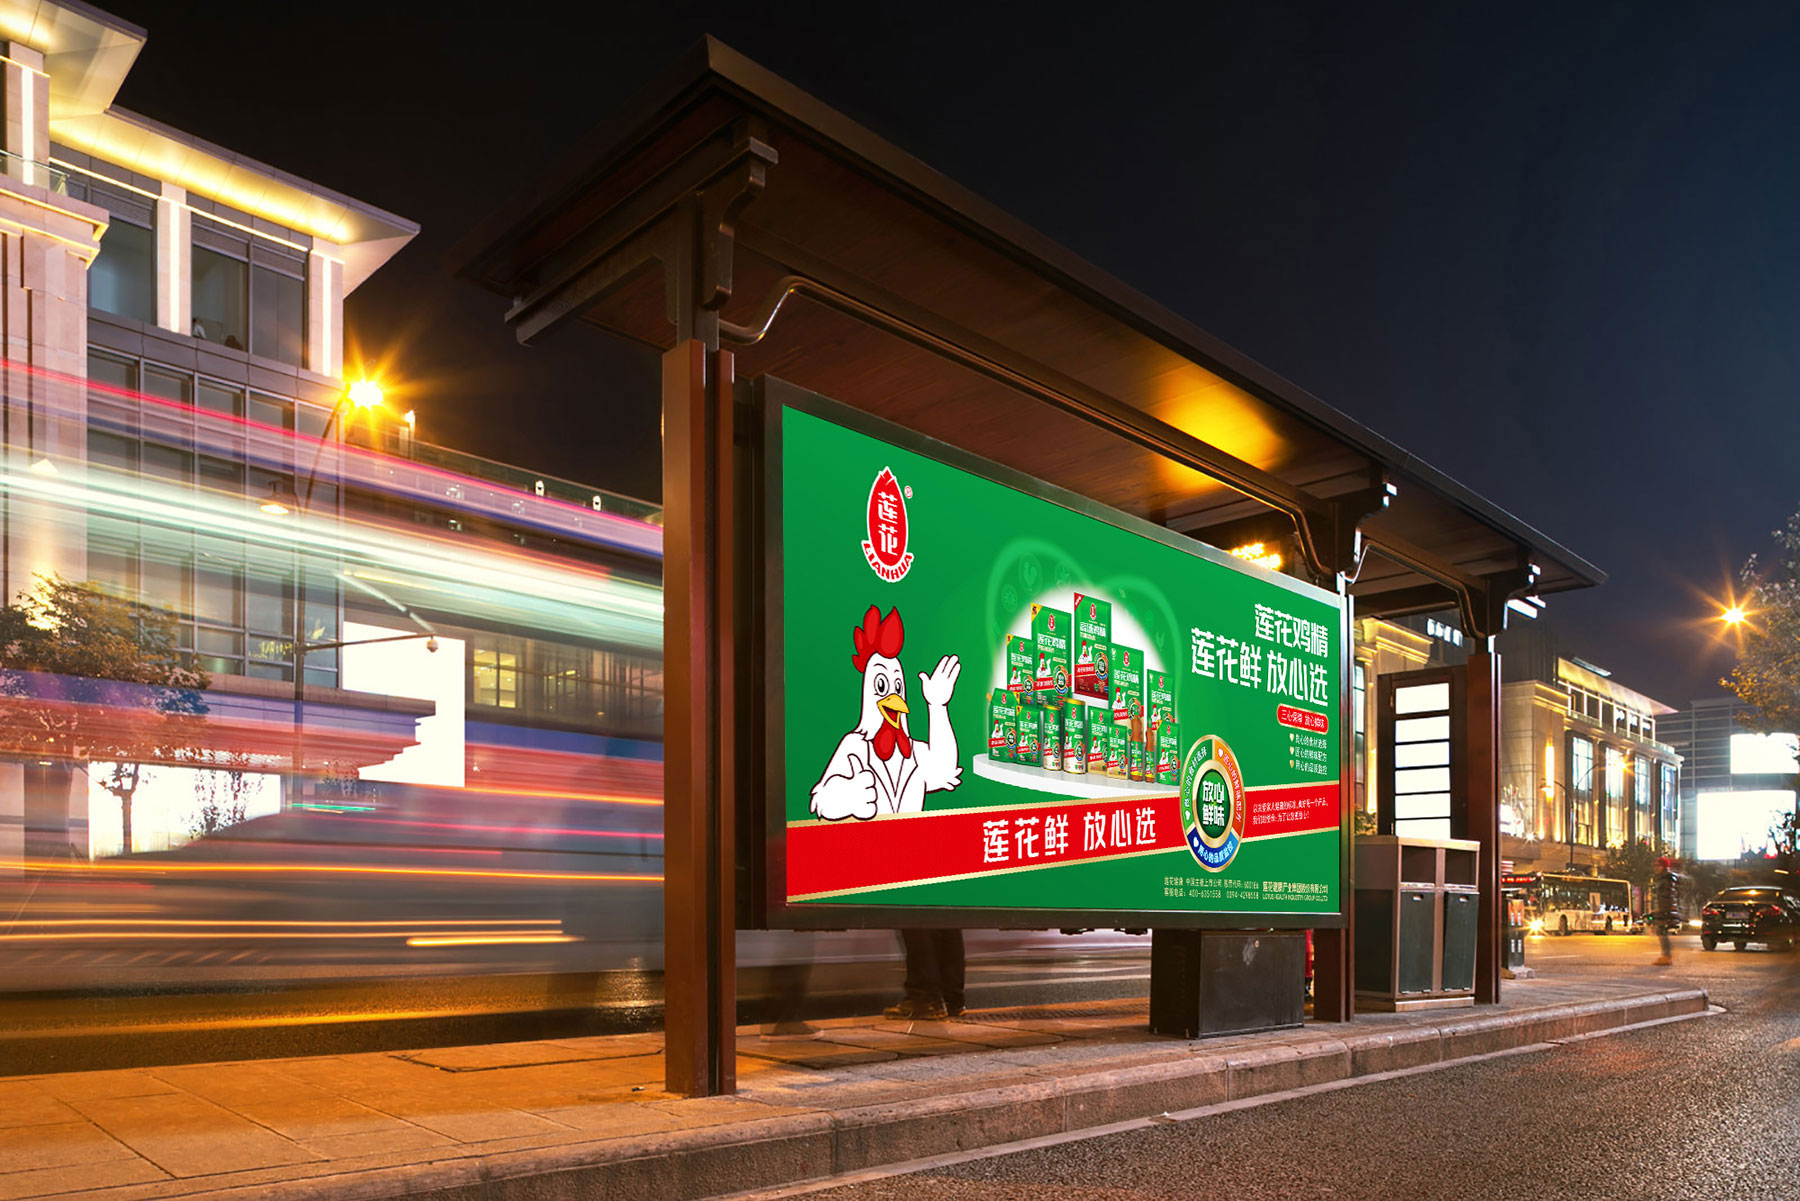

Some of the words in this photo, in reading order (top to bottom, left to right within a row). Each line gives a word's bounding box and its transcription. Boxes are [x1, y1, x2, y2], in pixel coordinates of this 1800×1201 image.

[878, 491, 898, 556] 莲花
[862, 542, 914, 582] LIANHUA
[1255, 603, 1328, 658] 莲花鸡精
[1191, 627, 1261, 689] 莲花鲜
[1267, 649, 1328, 706] 放心选
[1295, 733, 1328, 749] 良心的食材选择
[1203, 781, 1225, 804] 放心
[983, 813, 1069, 863] 莲花鲜
[1083, 806, 1157, 851] 放心选
[1203, 804, 1225, 827] 鲜味
[1197, 840, 1235, 864] 用心的品质监控
